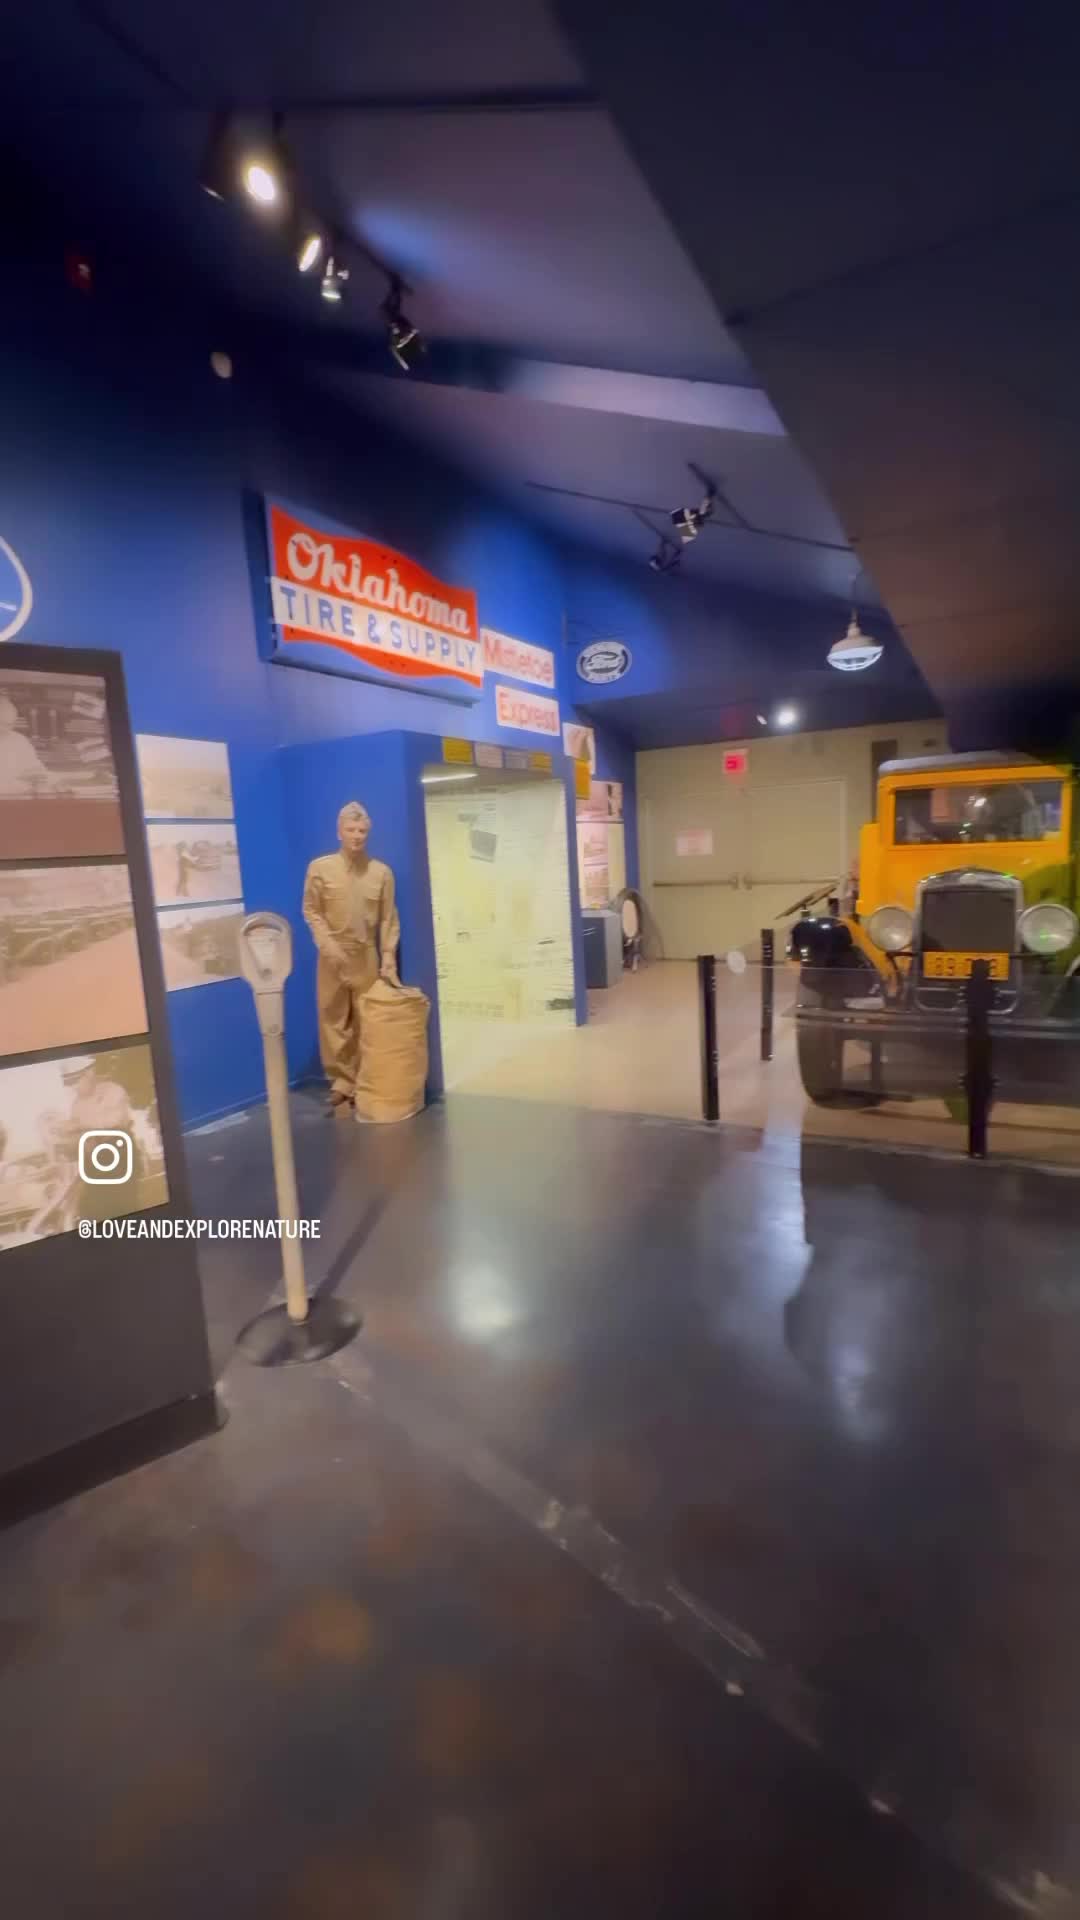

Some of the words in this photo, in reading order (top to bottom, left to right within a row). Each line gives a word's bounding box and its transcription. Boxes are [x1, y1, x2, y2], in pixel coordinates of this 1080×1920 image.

[280, 586, 355, 637] TIRE
[367, 613, 381, 644] &
[390, 620, 476, 671] SUPPLY
[287, 533, 471, 634] Oklahoma
